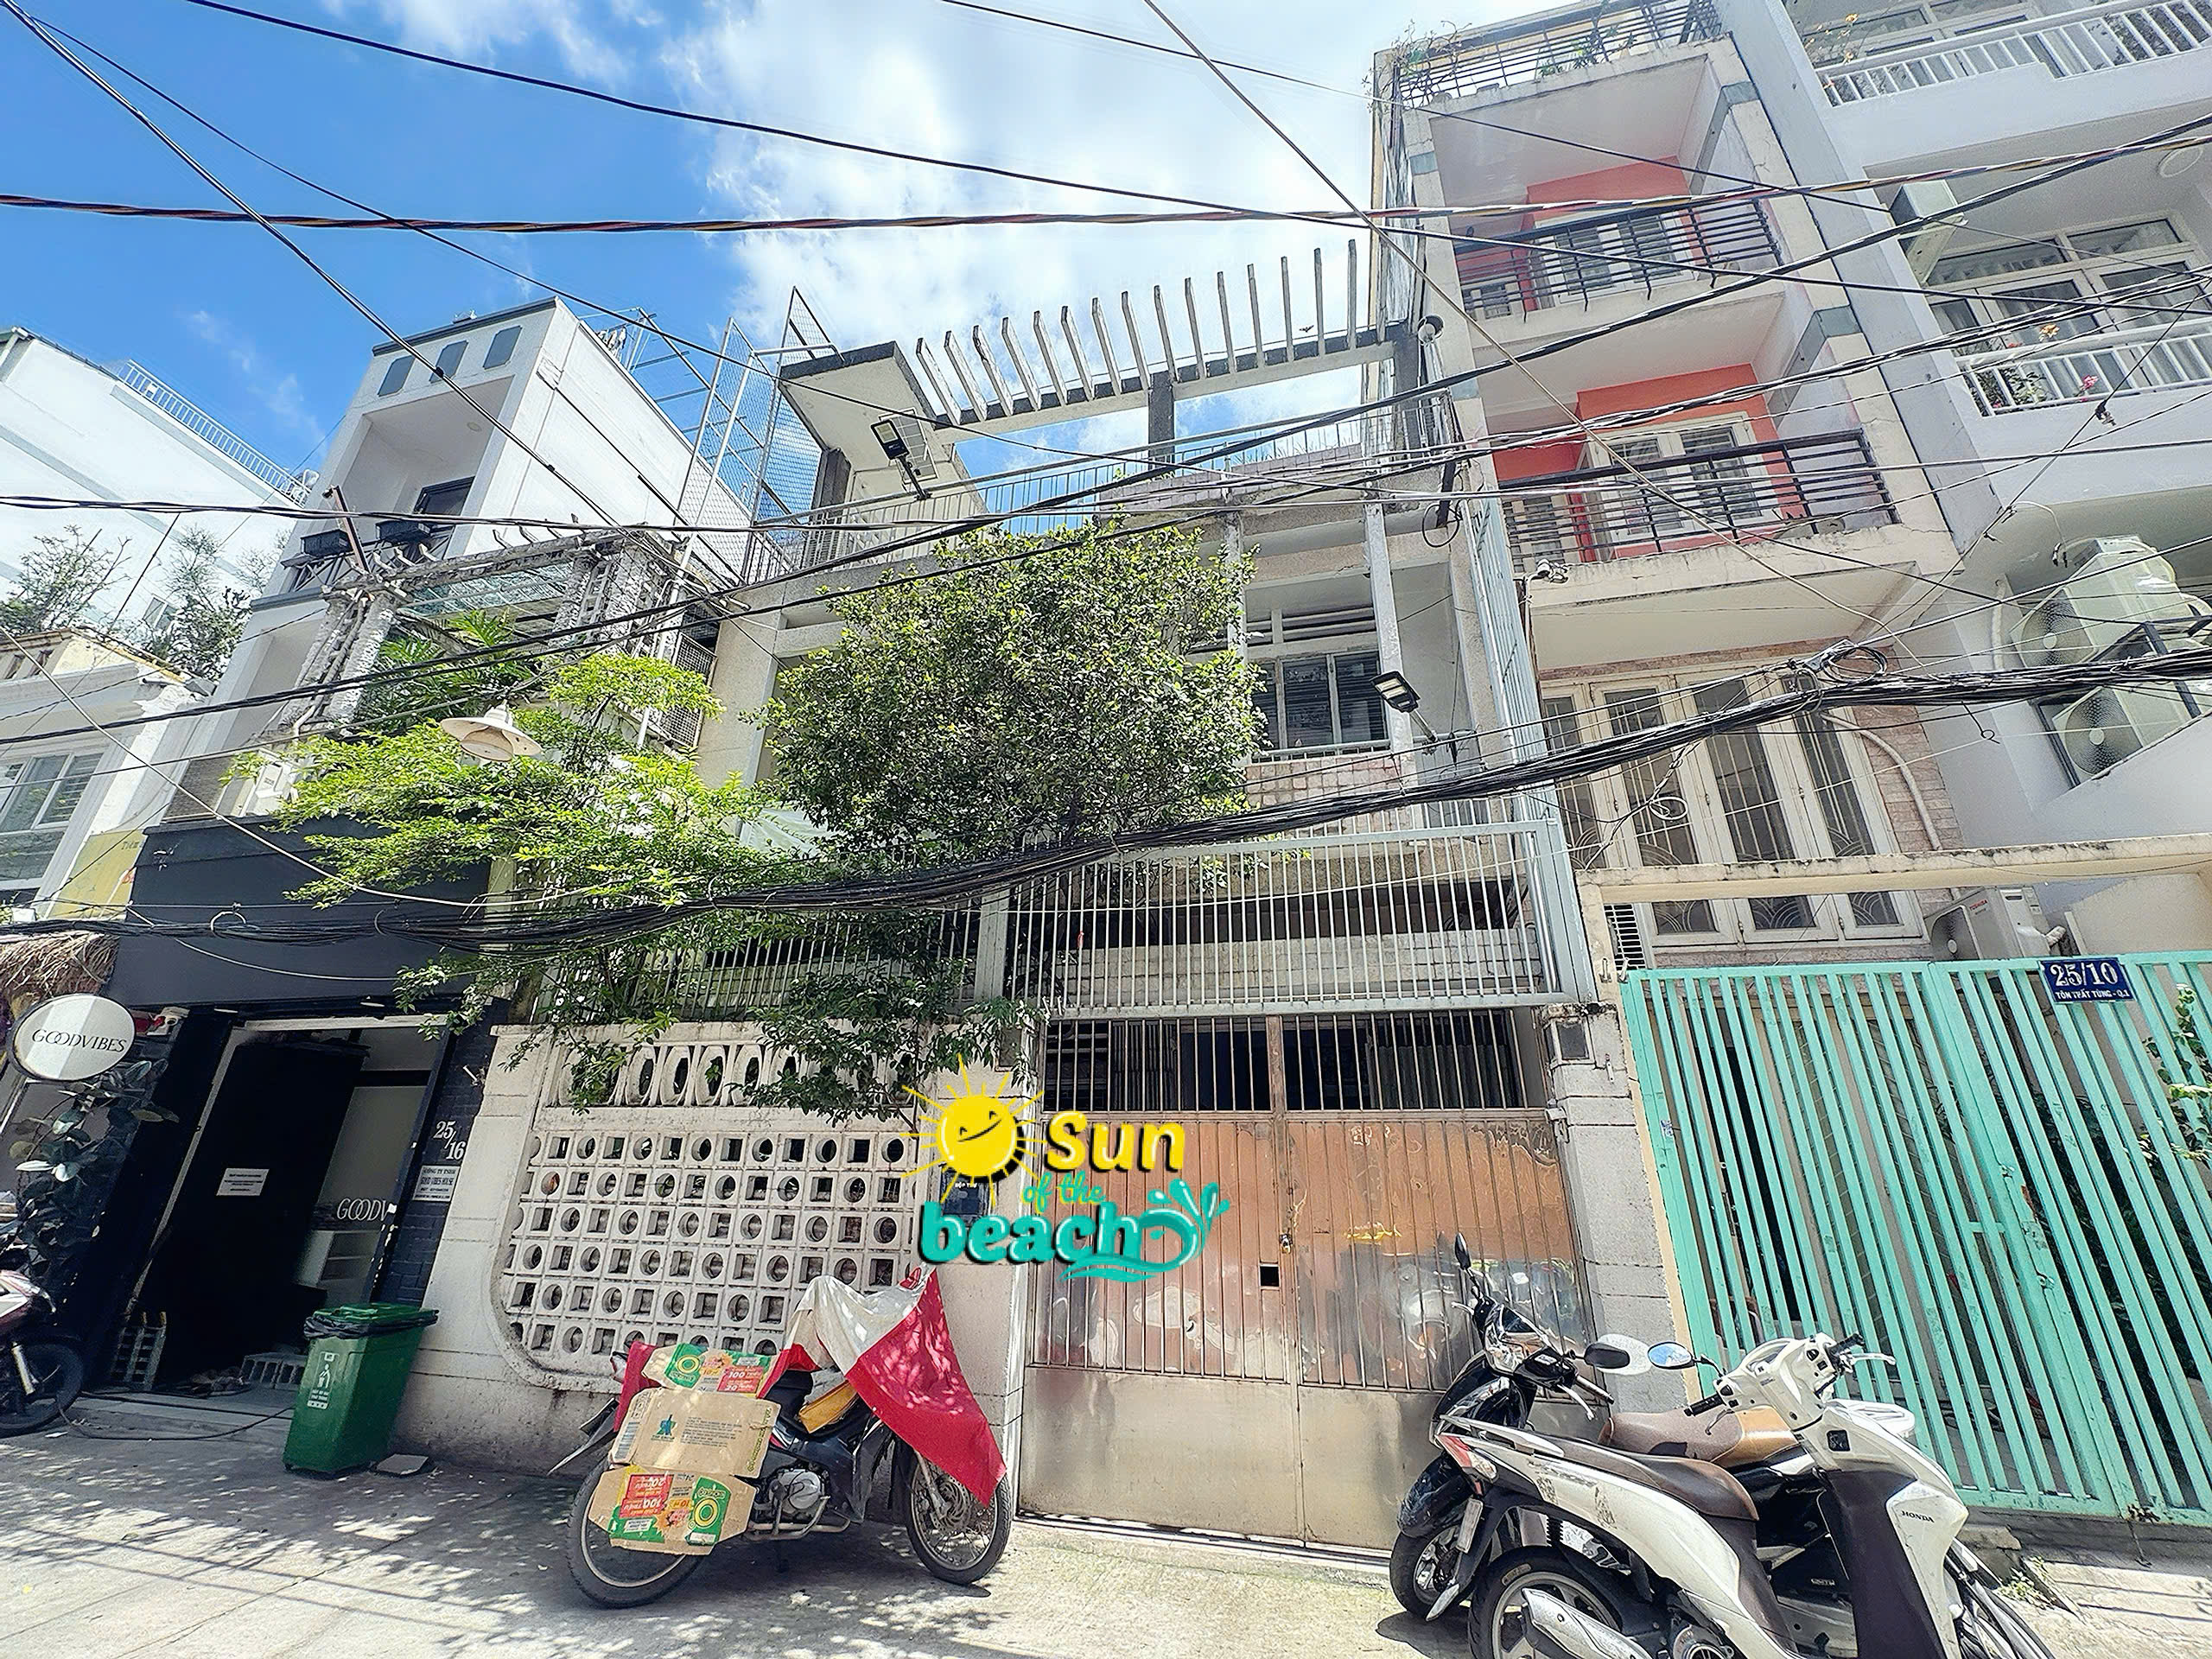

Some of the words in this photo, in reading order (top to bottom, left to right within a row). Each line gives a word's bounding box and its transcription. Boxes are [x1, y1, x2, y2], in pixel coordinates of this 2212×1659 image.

[2050, 962, 2118, 986] 25/10
[2055, 989, 2072, 1000] TÔN
[2091, 988, 2113, 998] TÙNG
[32, 1028, 127, 1052] GOODVIBES
[1901, 1510, 1935, 1523] HONDA
